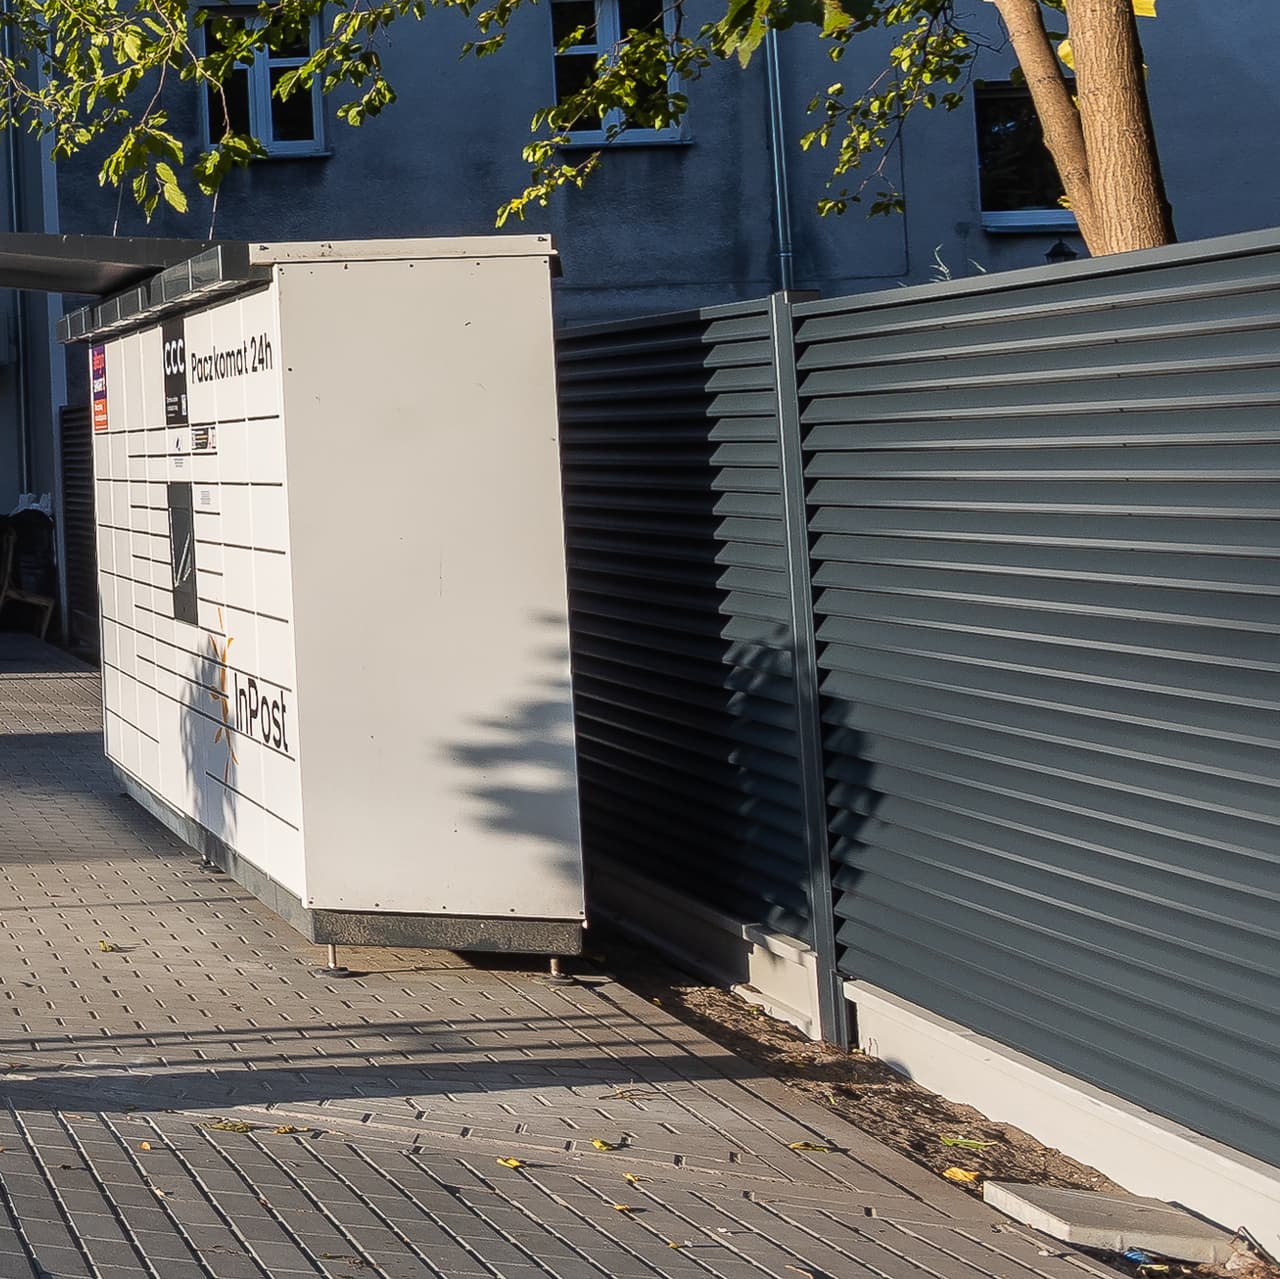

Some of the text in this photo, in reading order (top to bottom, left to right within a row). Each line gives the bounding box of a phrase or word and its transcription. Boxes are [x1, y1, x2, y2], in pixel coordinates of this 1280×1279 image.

[164, 338, 185, 376] CCC
[190, 332, 273, 385] Paczkomat 24h
[233, 671, 289, 753] InPost
